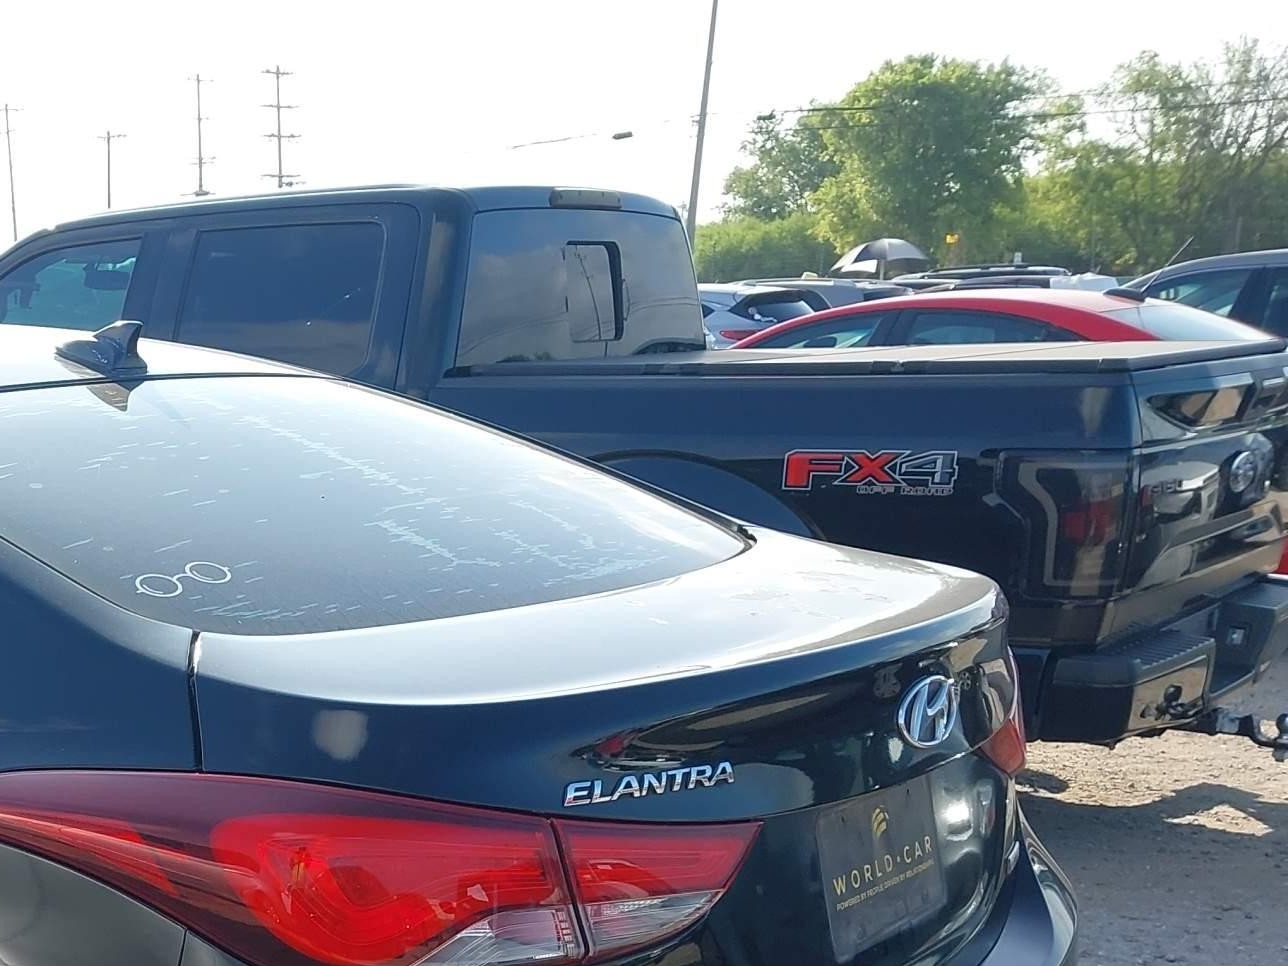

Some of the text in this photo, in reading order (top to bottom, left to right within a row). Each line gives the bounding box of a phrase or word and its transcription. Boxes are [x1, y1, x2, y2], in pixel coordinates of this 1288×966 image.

[782, 449, 958, 491] FX4
[856, 485, 954, 496] OFF ROAD
[564, 761, 735, 807] ELANTRA
